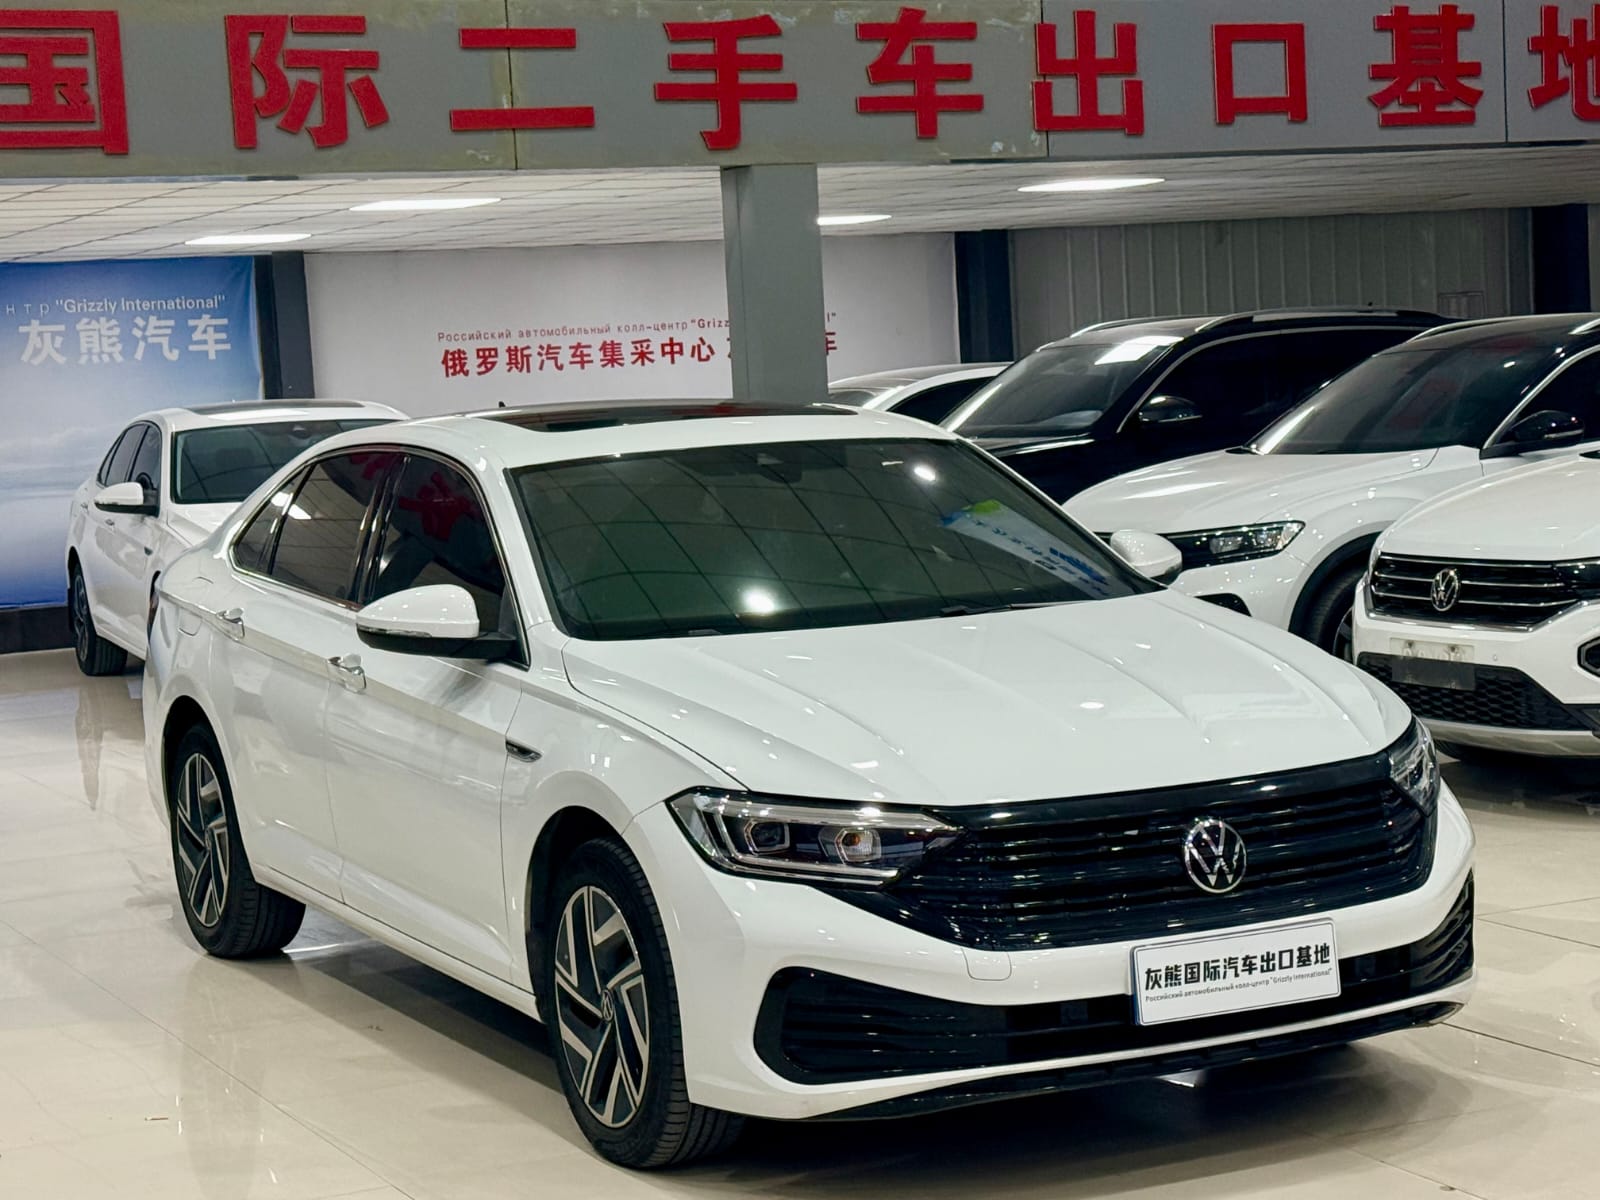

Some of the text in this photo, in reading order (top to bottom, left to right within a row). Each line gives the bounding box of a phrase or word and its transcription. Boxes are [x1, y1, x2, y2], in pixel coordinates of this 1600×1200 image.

[0, 4, 1600, 155] 国际二手车出口基地
[56, 298, 117, 314] "Grizzly
[121, 295, 225, 311] International"
[18, 314, 231, 365] 灰熊汽车
[437, 317, 730, 342] Российский автомобильный колл-центр "Grizz
[441, 336, 716, 378] 俄罗斯汽车集采中心
[1144, 942, 1331, 991] 灰熊国际汽车出口基地
